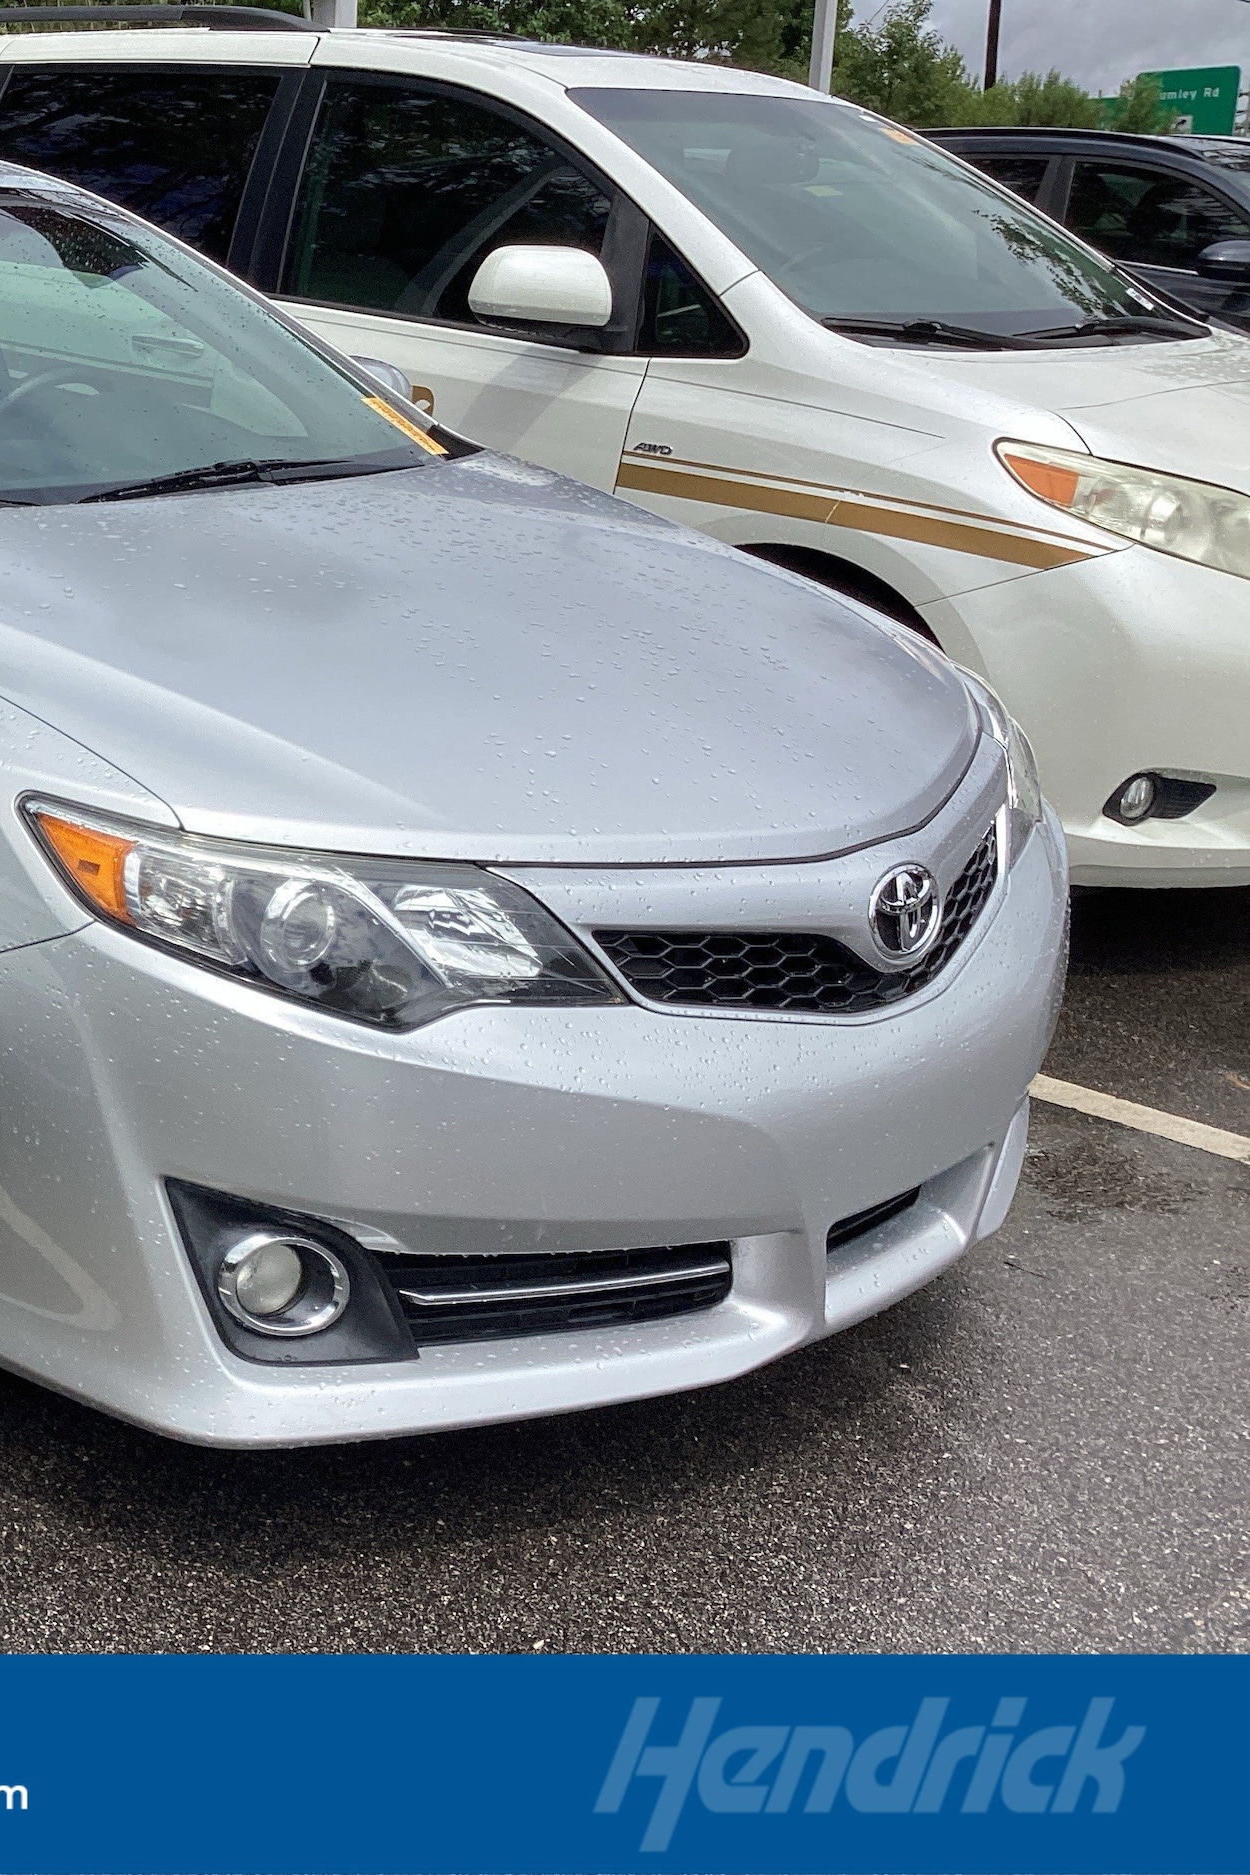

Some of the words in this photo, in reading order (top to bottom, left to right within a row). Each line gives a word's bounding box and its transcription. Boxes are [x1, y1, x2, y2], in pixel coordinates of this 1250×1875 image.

[1158, 89, 1198, 101] umley
[1202, 87, 1220, 98] Rd
[633, 442, 673, 455] AWD
